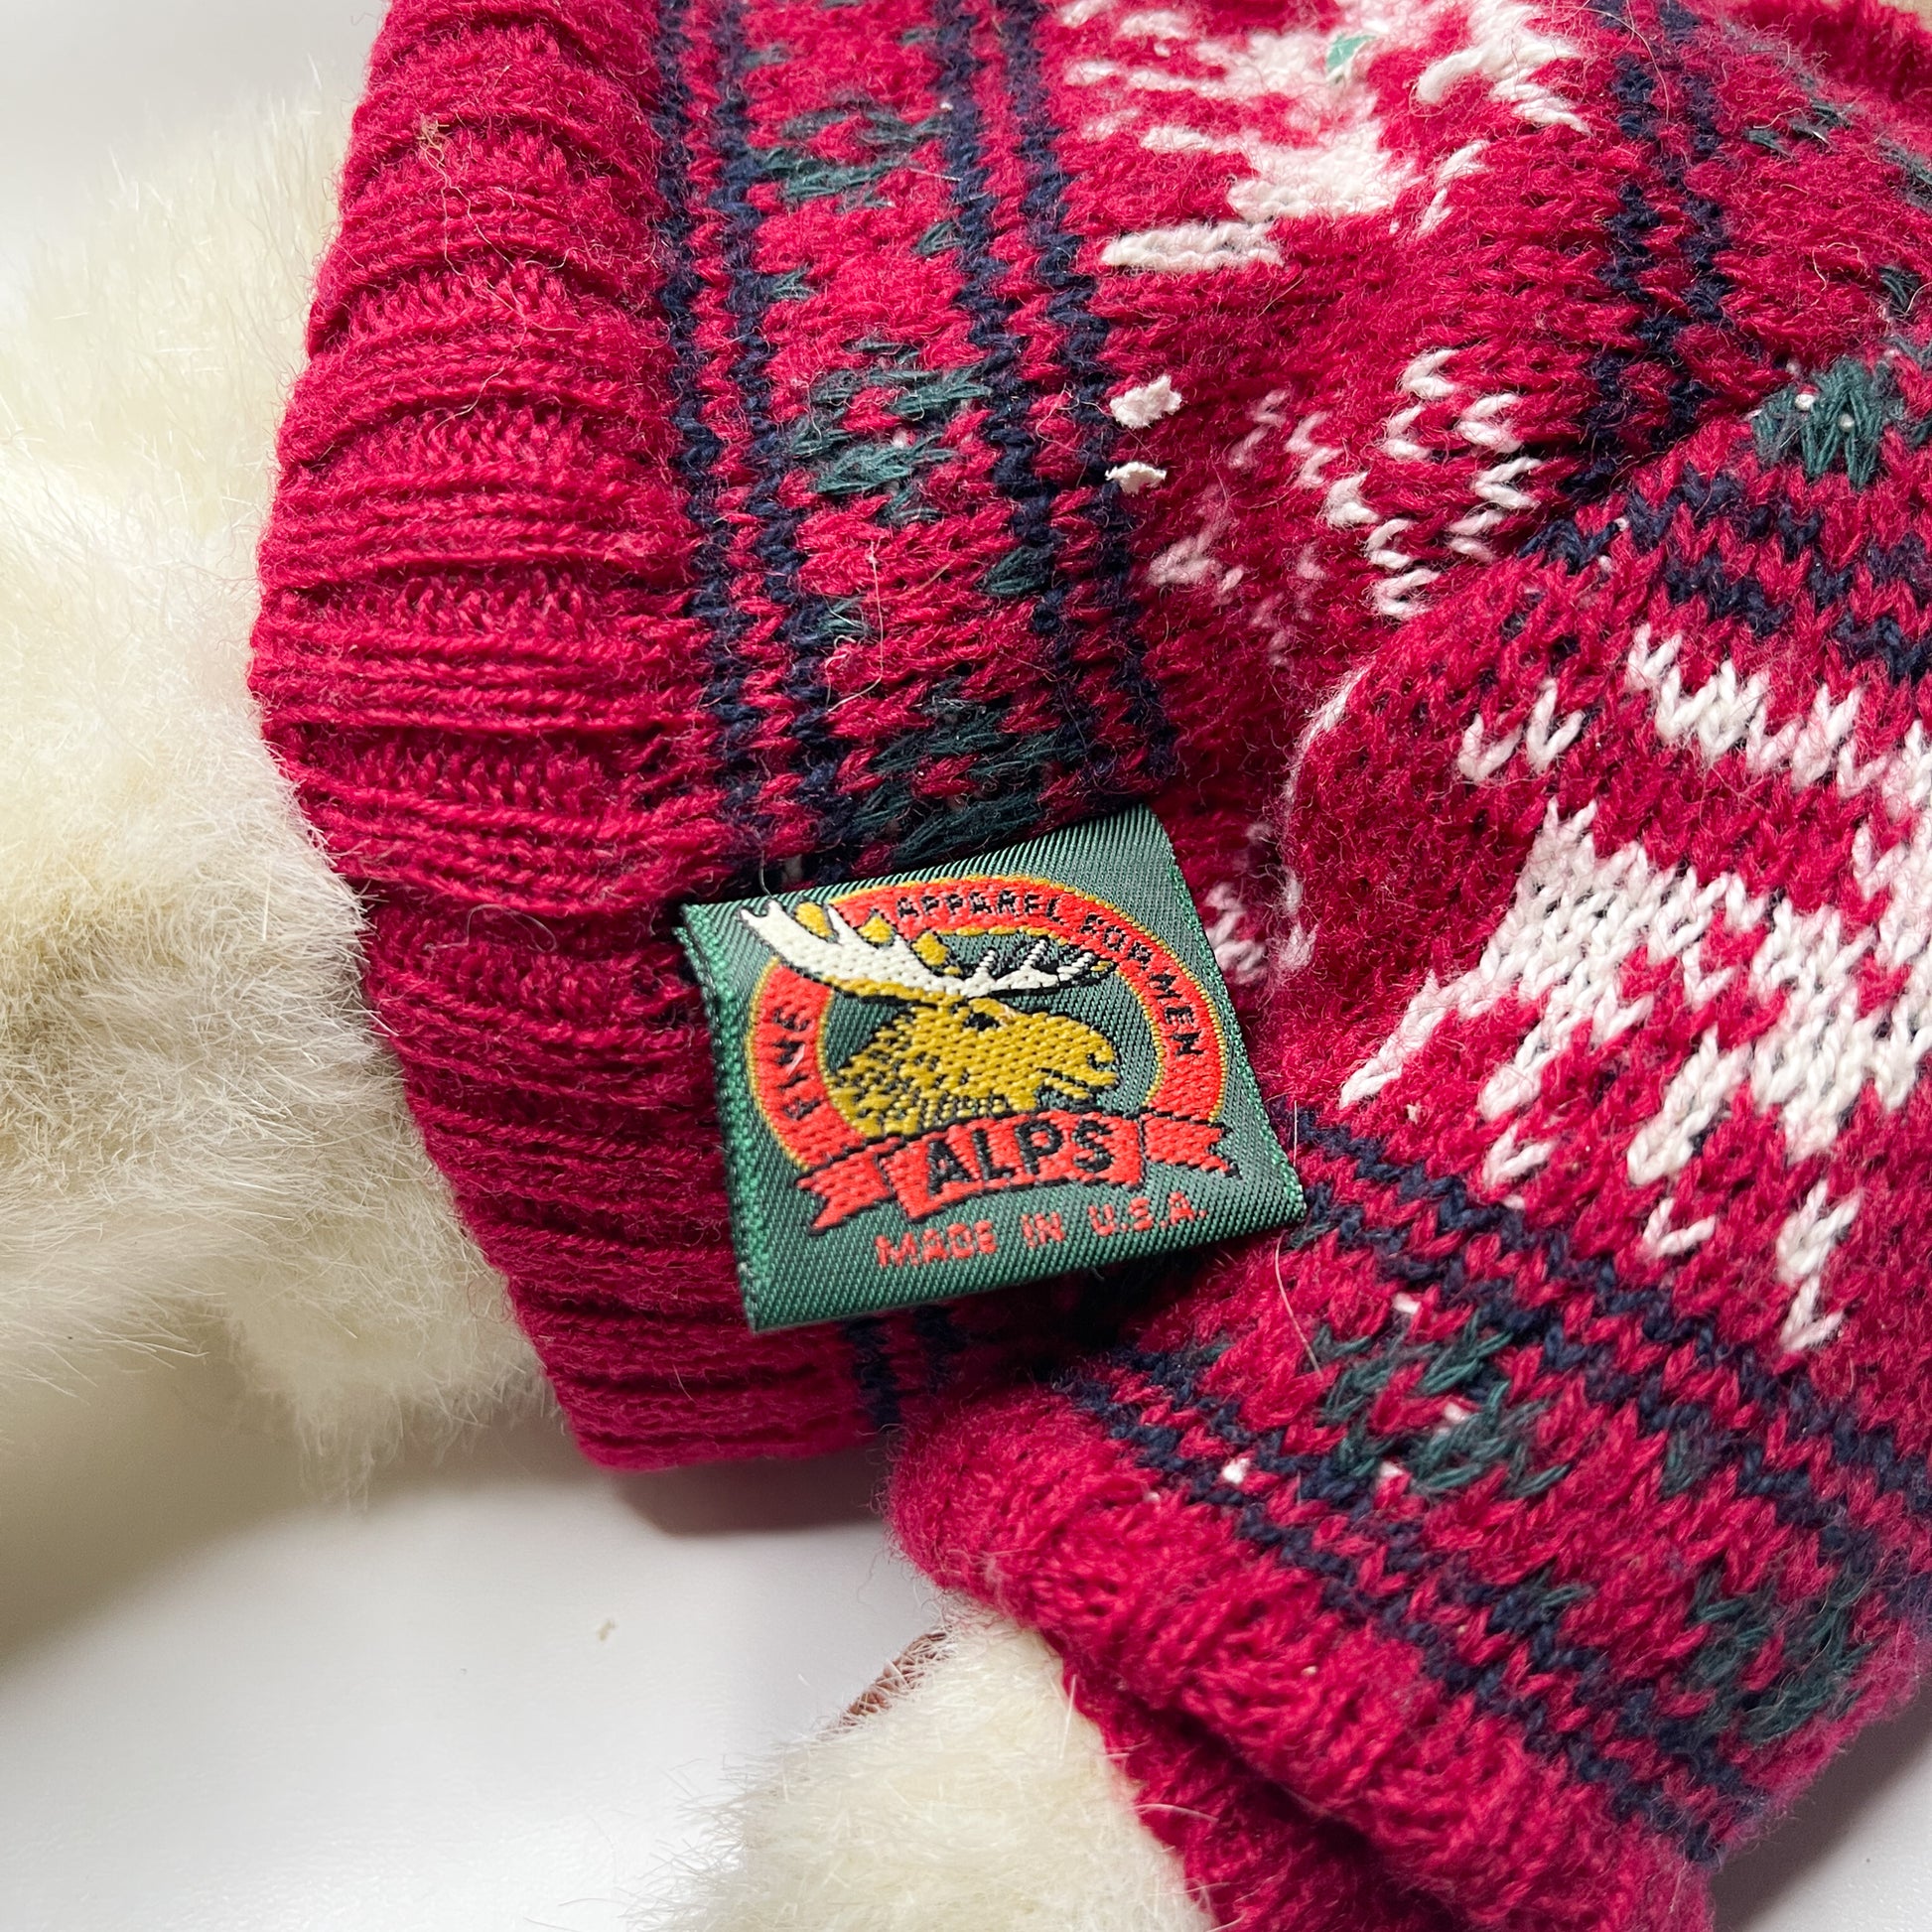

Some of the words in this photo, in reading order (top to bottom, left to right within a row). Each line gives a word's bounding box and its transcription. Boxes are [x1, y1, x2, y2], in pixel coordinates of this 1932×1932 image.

[897, 890, 1065, 924] APPAREL
[1079, 913, 1154, 966] FOR
[1149, 972, 1204, 1056] MEN
[925, 1118, 1114, 1195] ALPS
[874, 1219, 999, 1269] MADE
[1020, 1210, 1066, 1249] IN
[1087, 1190, 1208, 1238] U.S.A.
